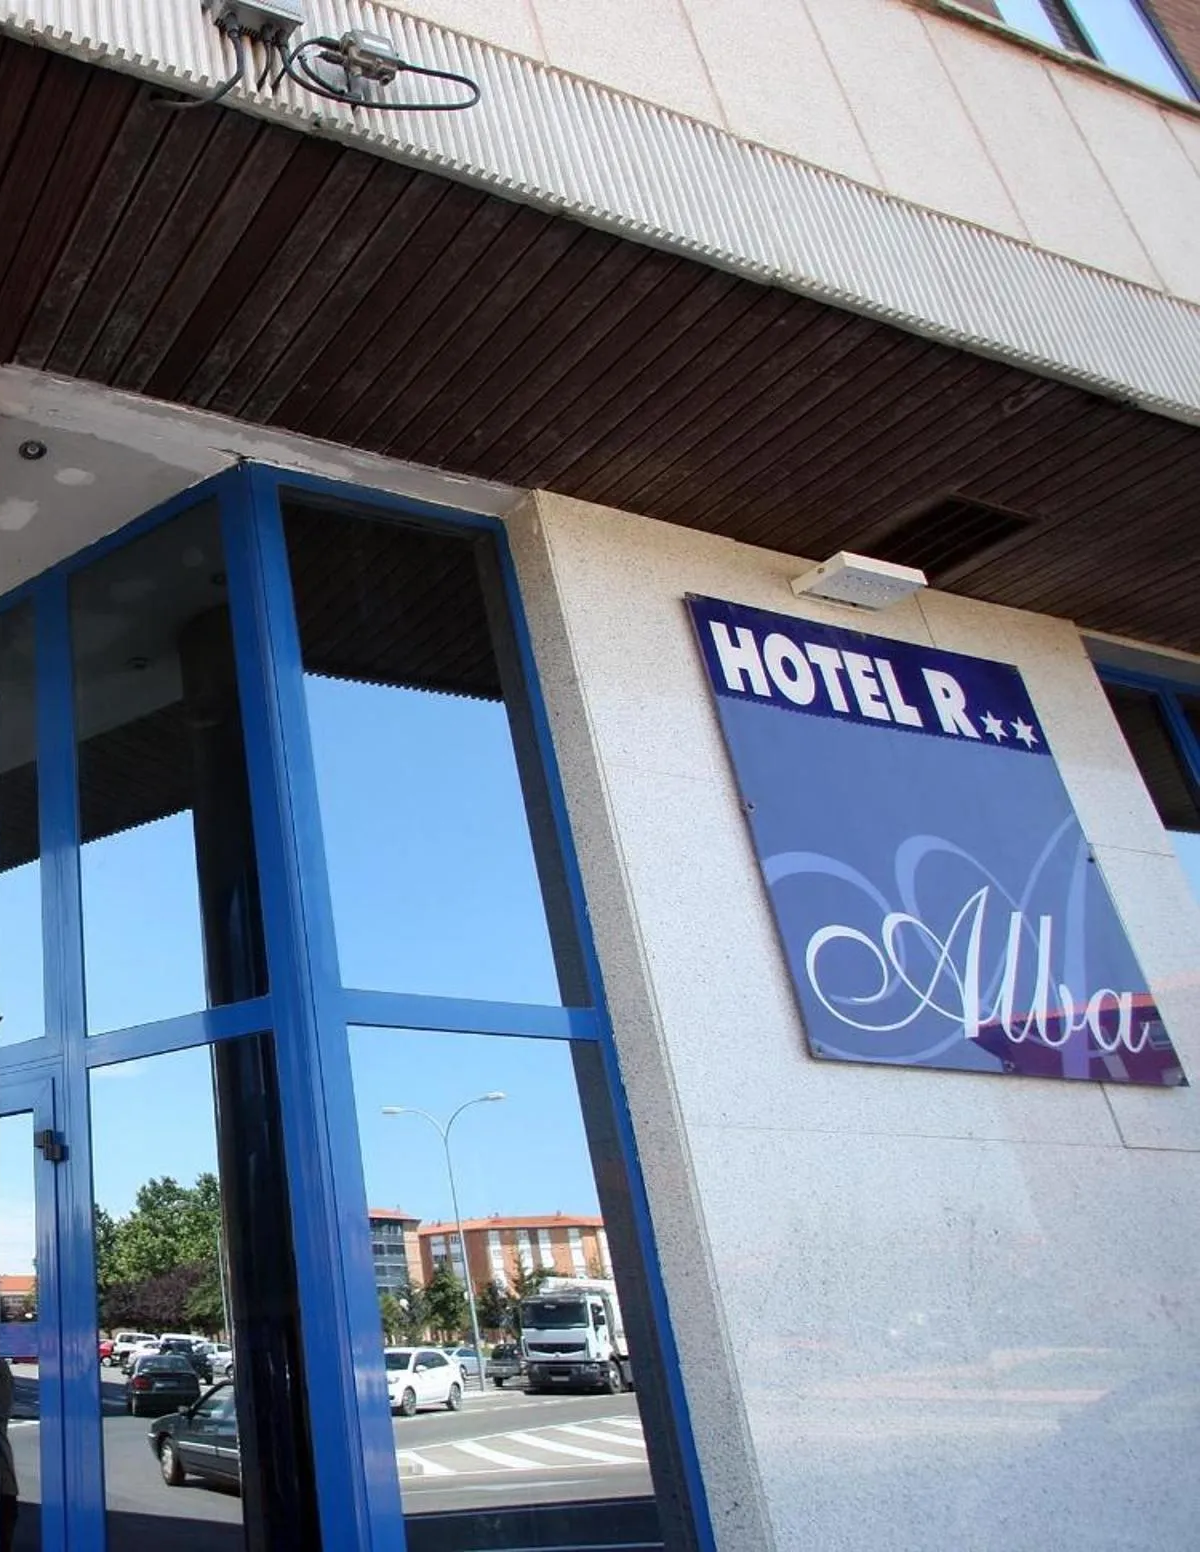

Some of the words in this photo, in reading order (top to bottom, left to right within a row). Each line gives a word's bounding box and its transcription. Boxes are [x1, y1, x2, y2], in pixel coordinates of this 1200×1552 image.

[709, 620, 923, 728] HOTEL
[922, 667, 980, 739] R
[805, 885, 1149, 1053] Alba
